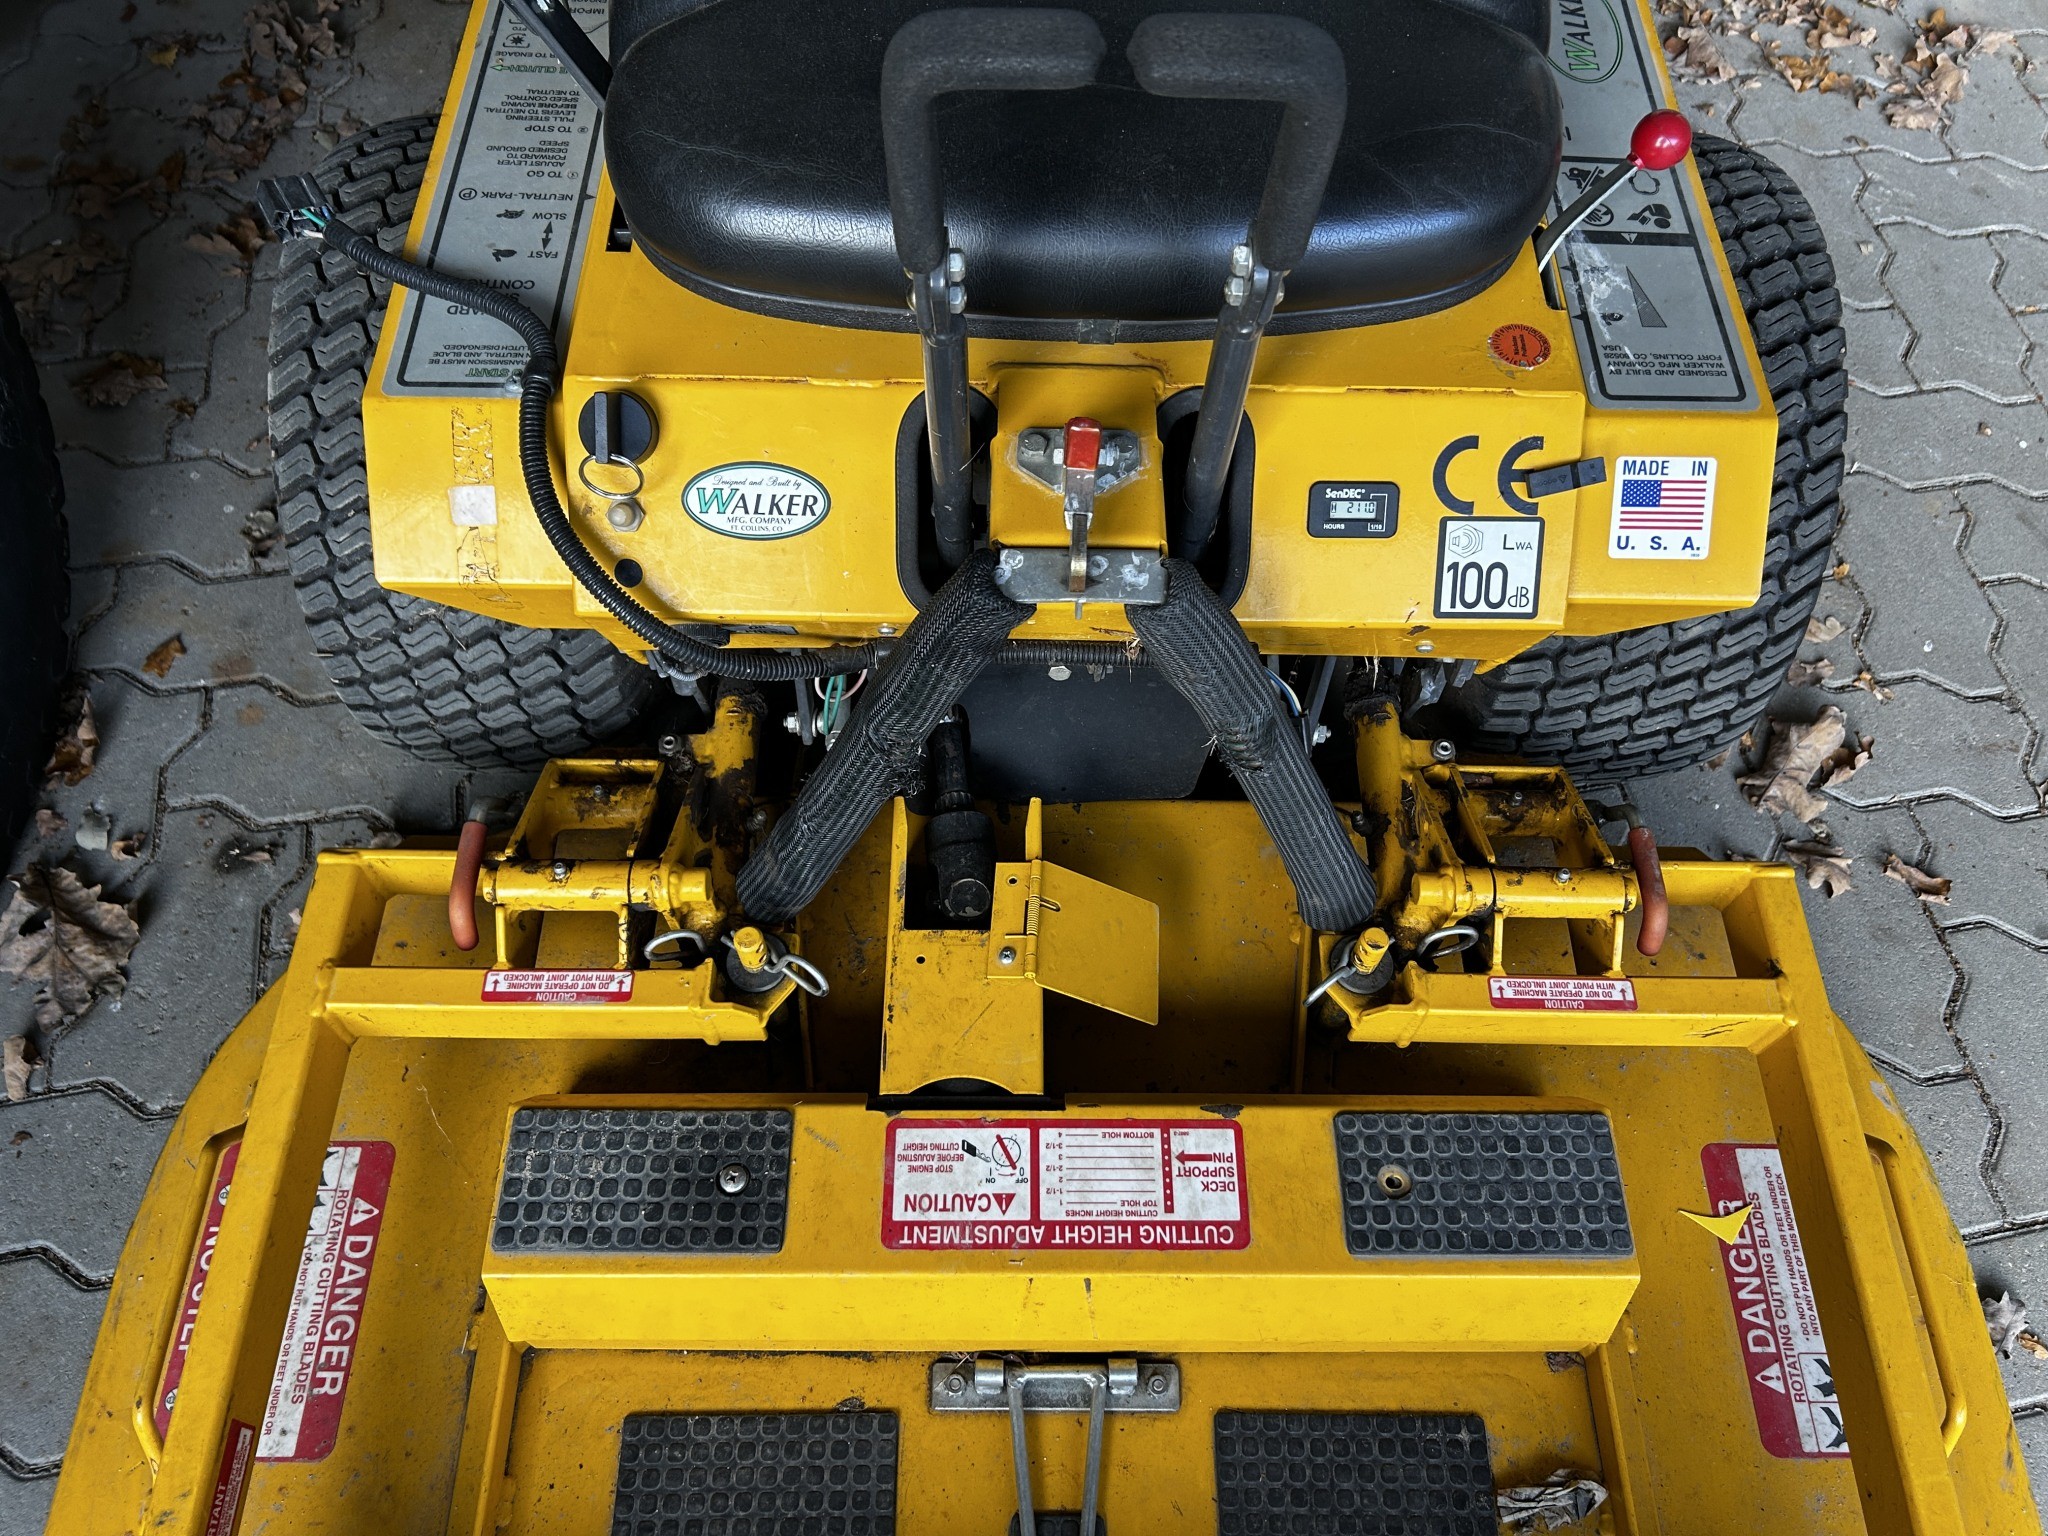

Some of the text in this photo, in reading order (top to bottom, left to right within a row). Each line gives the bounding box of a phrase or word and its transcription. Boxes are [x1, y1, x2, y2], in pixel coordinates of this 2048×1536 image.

[1559, 0, 1600, 71] WALK
[504, 94, 548, 102] CONTROL
[483, 107, 526, 115] NEUTRAL
[505, 114, 550, 122] STEERING
[524, 125, 555, 133] STOP
[481, 191, 573, 201] NEUTRAL-PARK
[532, 212, 567, 220] SLOW
[527, 250, 558, 259] FAST
[1650, 352, 1694, 360] COLLINS,
[467, 358, 528, 366] RANSMISSION
[1606, 360, 1655, 368] COMPANY
[1683, 361, 1725, 369] WALKER
[465, 368, 510, 377] START
[1678, 369, 1727, 377] DESIGNED
[1622, 460, 1708, 476] MADE IN
[712, 475, 802, 490] Designed and Built by
[696, 488, 818, 516] WALKER
[726, 516, 793, 525] MFG. COMPANY
[1616, 535, 1700, 551] U. S. A.
[1446, 561, 1529, 610] 100 dB
[504, 973, 545, 981] UNLOCKED
[1507, 980, 1616, 990] WITH PIVOT JOINT UNLOCKED
[535, 992, 577, 1001] CAUTION
[1512, 989, 1547, 997] MACHINE
[1549, 990, 1583, 998] OPERATE
[1544, 1000, 1585, 1009] CAUTION
[902, 1142, 960, 1150] CUTTING HEIGHT
[897, 1153, 965, 1162] BEFORE ADJUSTING
[1213, 1152, 1234, 1163] PIN
[908, 1165, 954, 1173] STOP ENGINE
[1176, 1166, 1235, 1177] SUPPORT
[1200, 1181, 1236, 1192] DECK
[904, 1193, 992, 1213] CAUTION
[1065, 1209, 1158, 1217] CUTTING HEIGHT INCHES
[898, 1224, 1235, 1245] CUTTING HEIGHT ADJUSTMENT
[1763, 1166, 1810, 1336] DO NOT PUT HANDS OR FEET UNDER OR
[1775, 1173, 1820, 1336] INTO ANY PART OF THIS MOWER DECK
[291, 1190, 350, 1405] ROTATING CUTTING BLADES
[1748, 1192, 1806, 1403] ROTATING CUTTING BLADES
[312, 1235, 374, 1396] DANGER
[263, 1252, 312, 1436] DO NOT PUT HANDS OR FEET UNDER OR
[207, 1481, 226, 1536] RTANT
